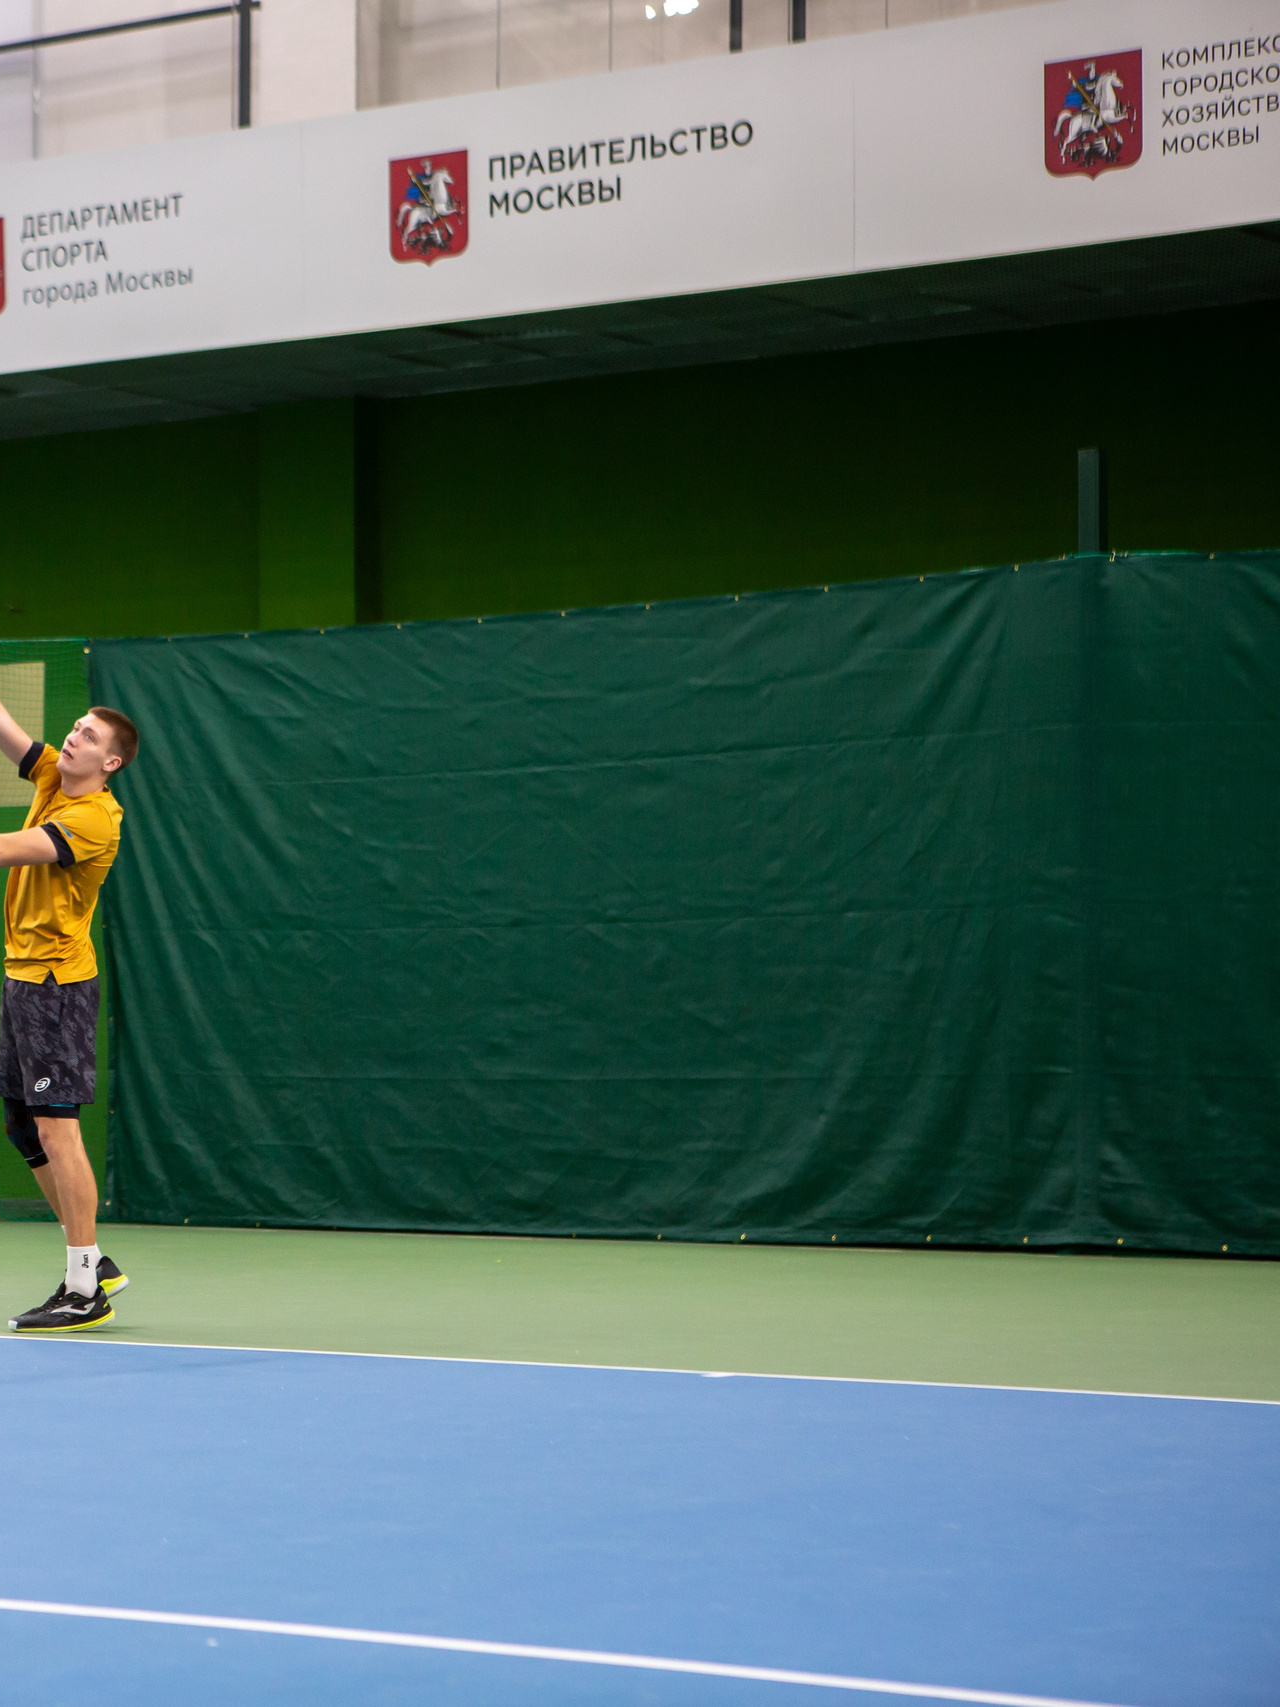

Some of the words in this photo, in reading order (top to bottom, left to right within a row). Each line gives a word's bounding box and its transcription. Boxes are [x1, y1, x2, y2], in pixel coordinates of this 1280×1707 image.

[488, 120, 754, 181] ПРАВИТЕЛЬСТВО
[1162, 124, 1260, 156] МОСКВЫ
[21, 192, 183, 243] ДЕПАРТАМЕНТ
[488, 176, 622, 218] МОСКВЫ
[21, 240, 109, 272] СПОРТА
[22, 280, 99, 308] города
[105, 268, 195, 295] Москвы
